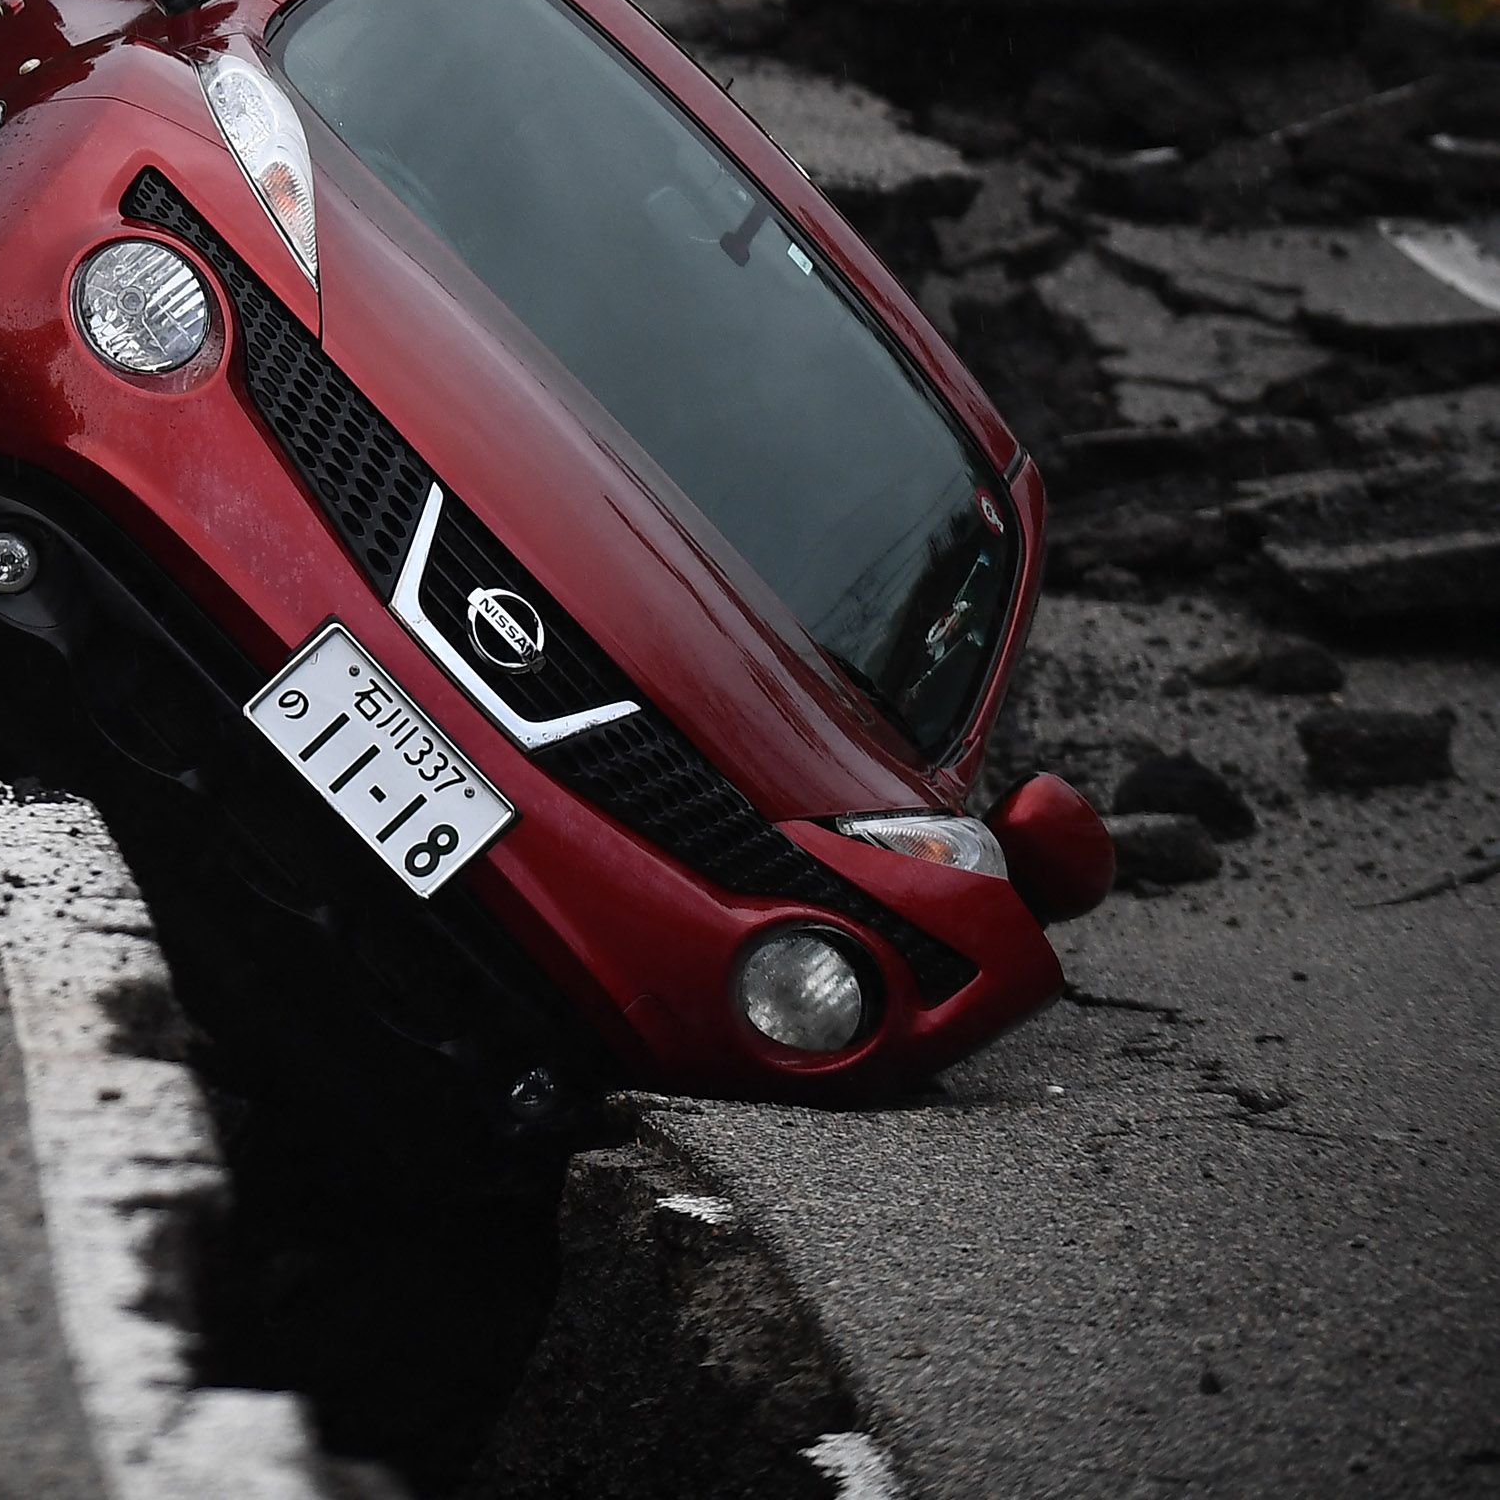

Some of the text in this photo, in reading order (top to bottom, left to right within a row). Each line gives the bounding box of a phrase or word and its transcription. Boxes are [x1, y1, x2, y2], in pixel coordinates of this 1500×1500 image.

[479, 597, 536, 661] NISSAN
[277, 689, 310, 720] の
[354, 679, 467, 792] 石川337
